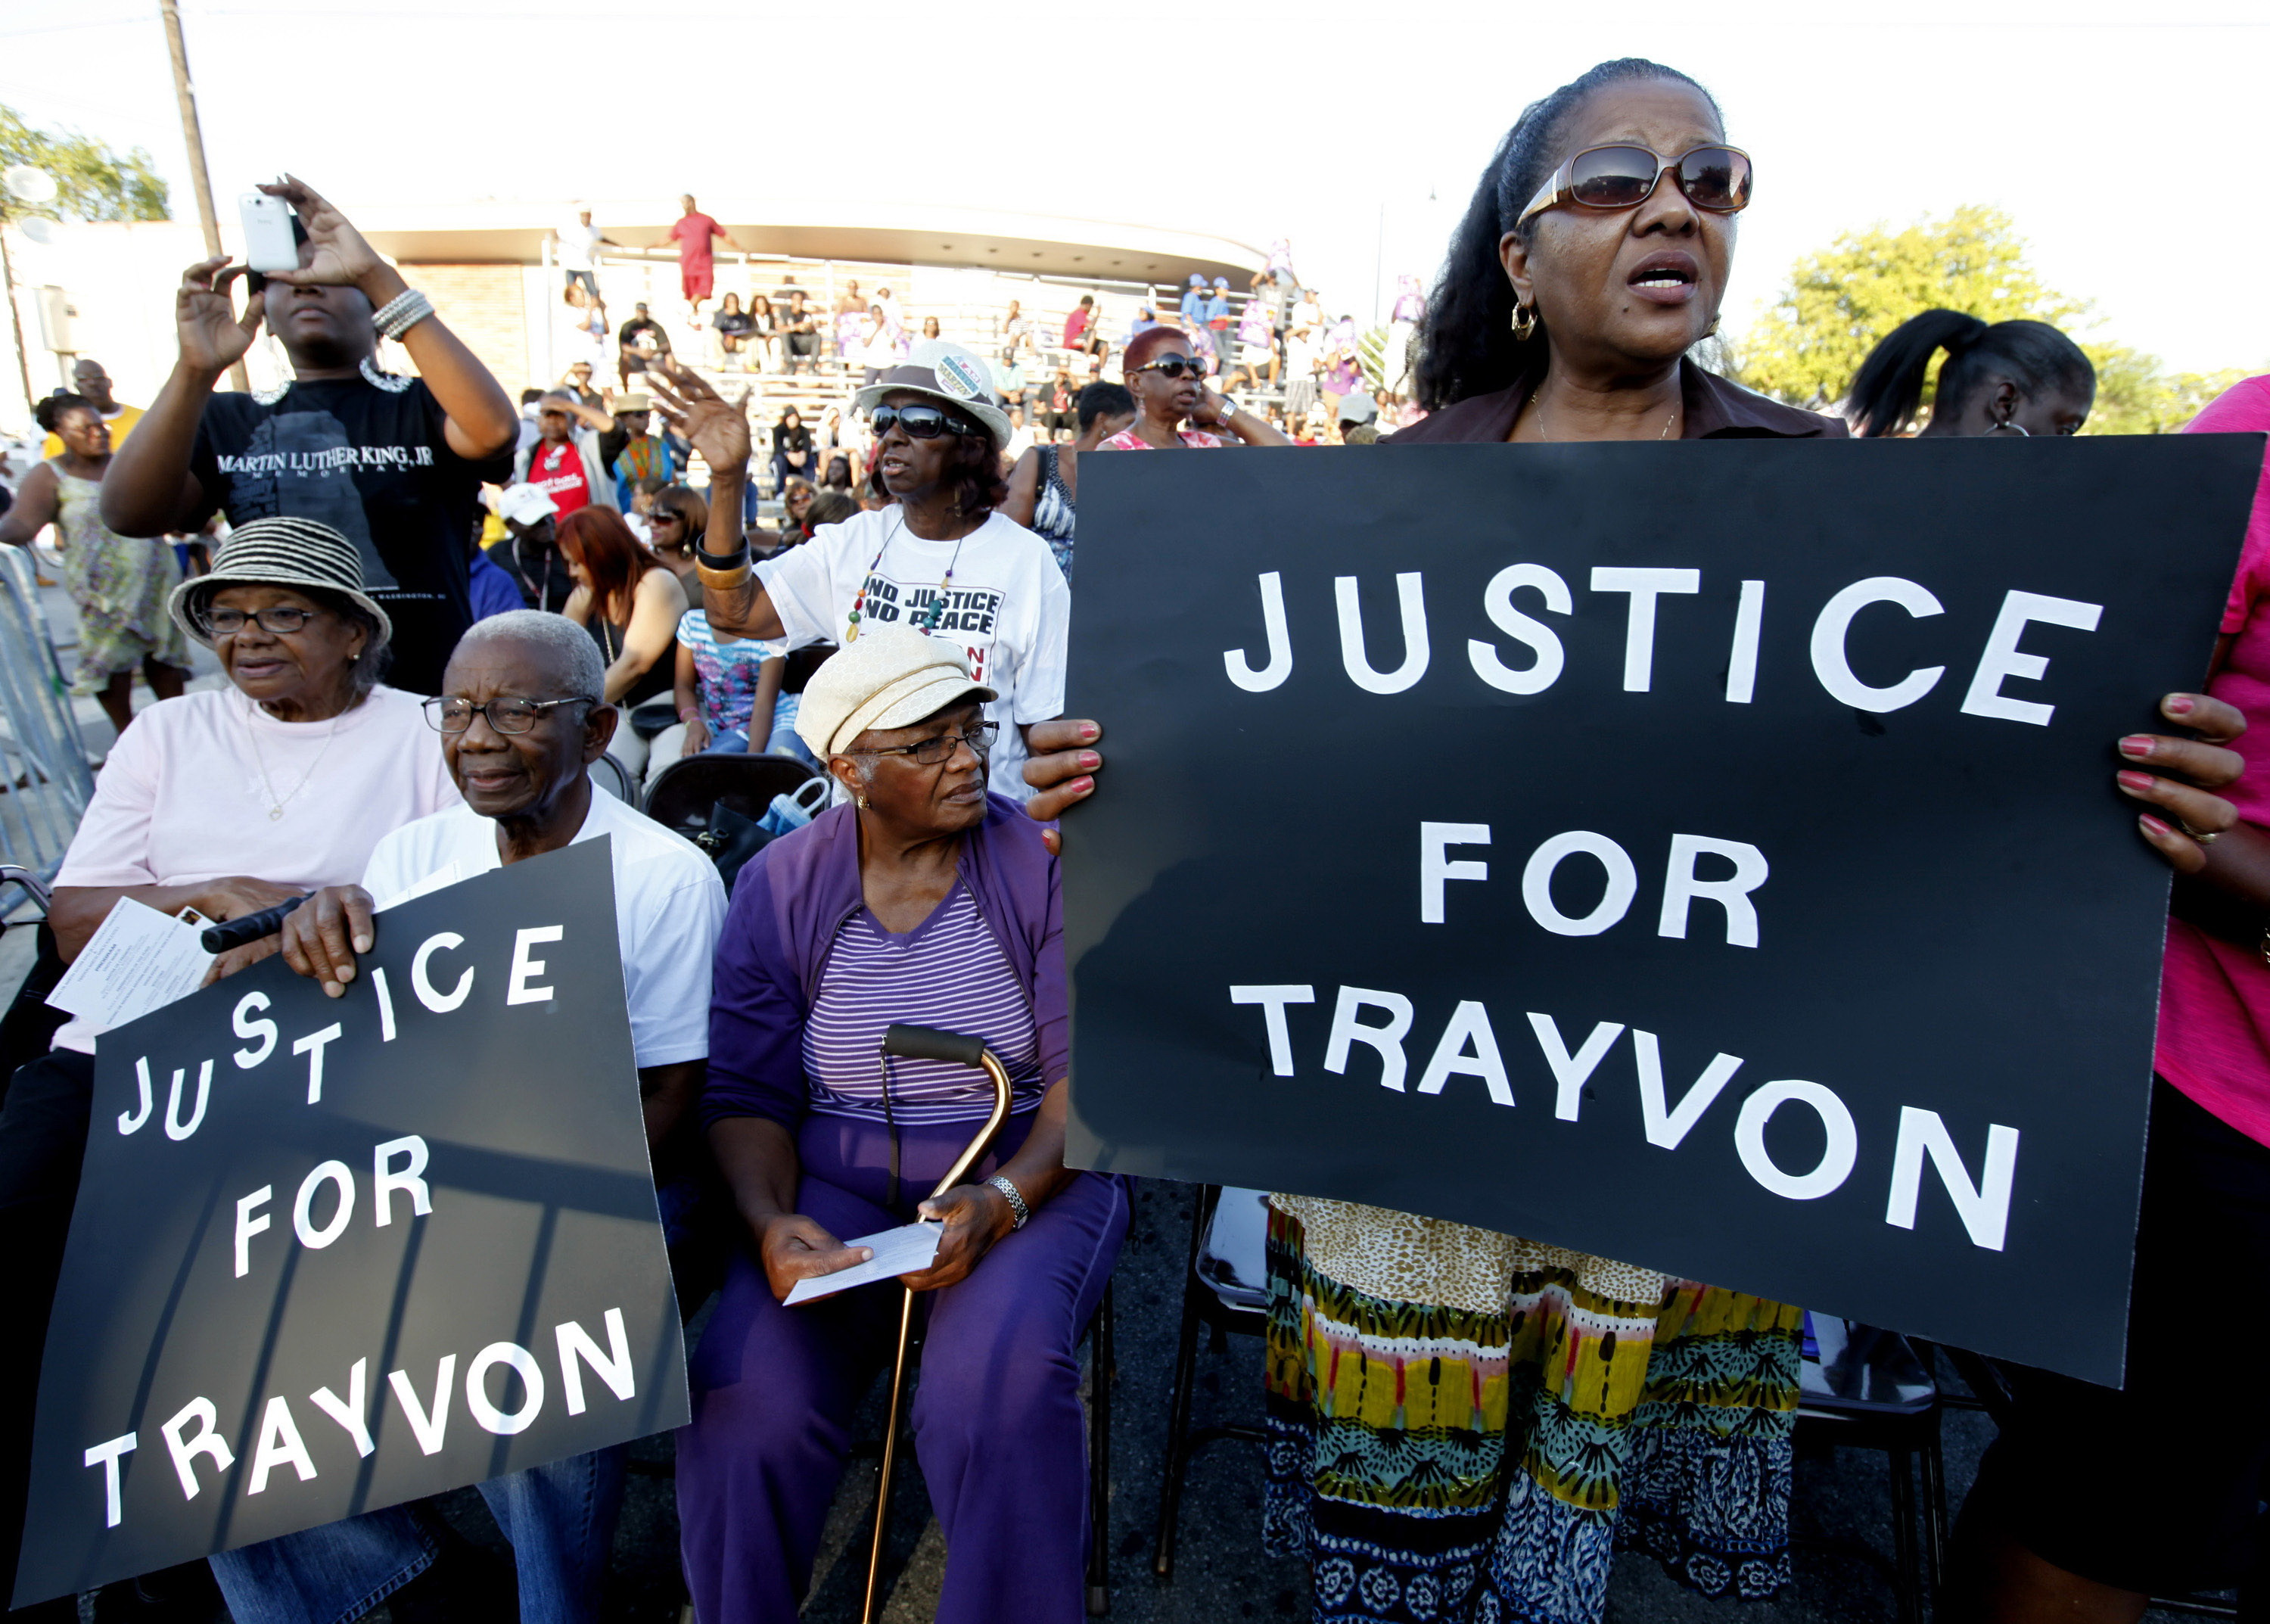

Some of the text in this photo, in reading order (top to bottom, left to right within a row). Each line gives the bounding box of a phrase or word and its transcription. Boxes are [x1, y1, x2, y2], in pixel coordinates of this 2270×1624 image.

[217, 453, 287, 474] MARTIN
[291, 447, 359, 472] LUTHER
[415, 445, 434, 466] JR
[864, 598, 900, 623] NO
[868, 577, 899, 603] NO
[1223, 563, 2104, 726] JUSTICE
[1420, 821, 1768, 948] FOR
[118, 924, 564, 1141] JUSTICE
[1229, 985, 2020, 1252] TRAYVON
[235, 1134, 434, 1279] FOR
[85, 1307, 636, 1528] TRAYVON
